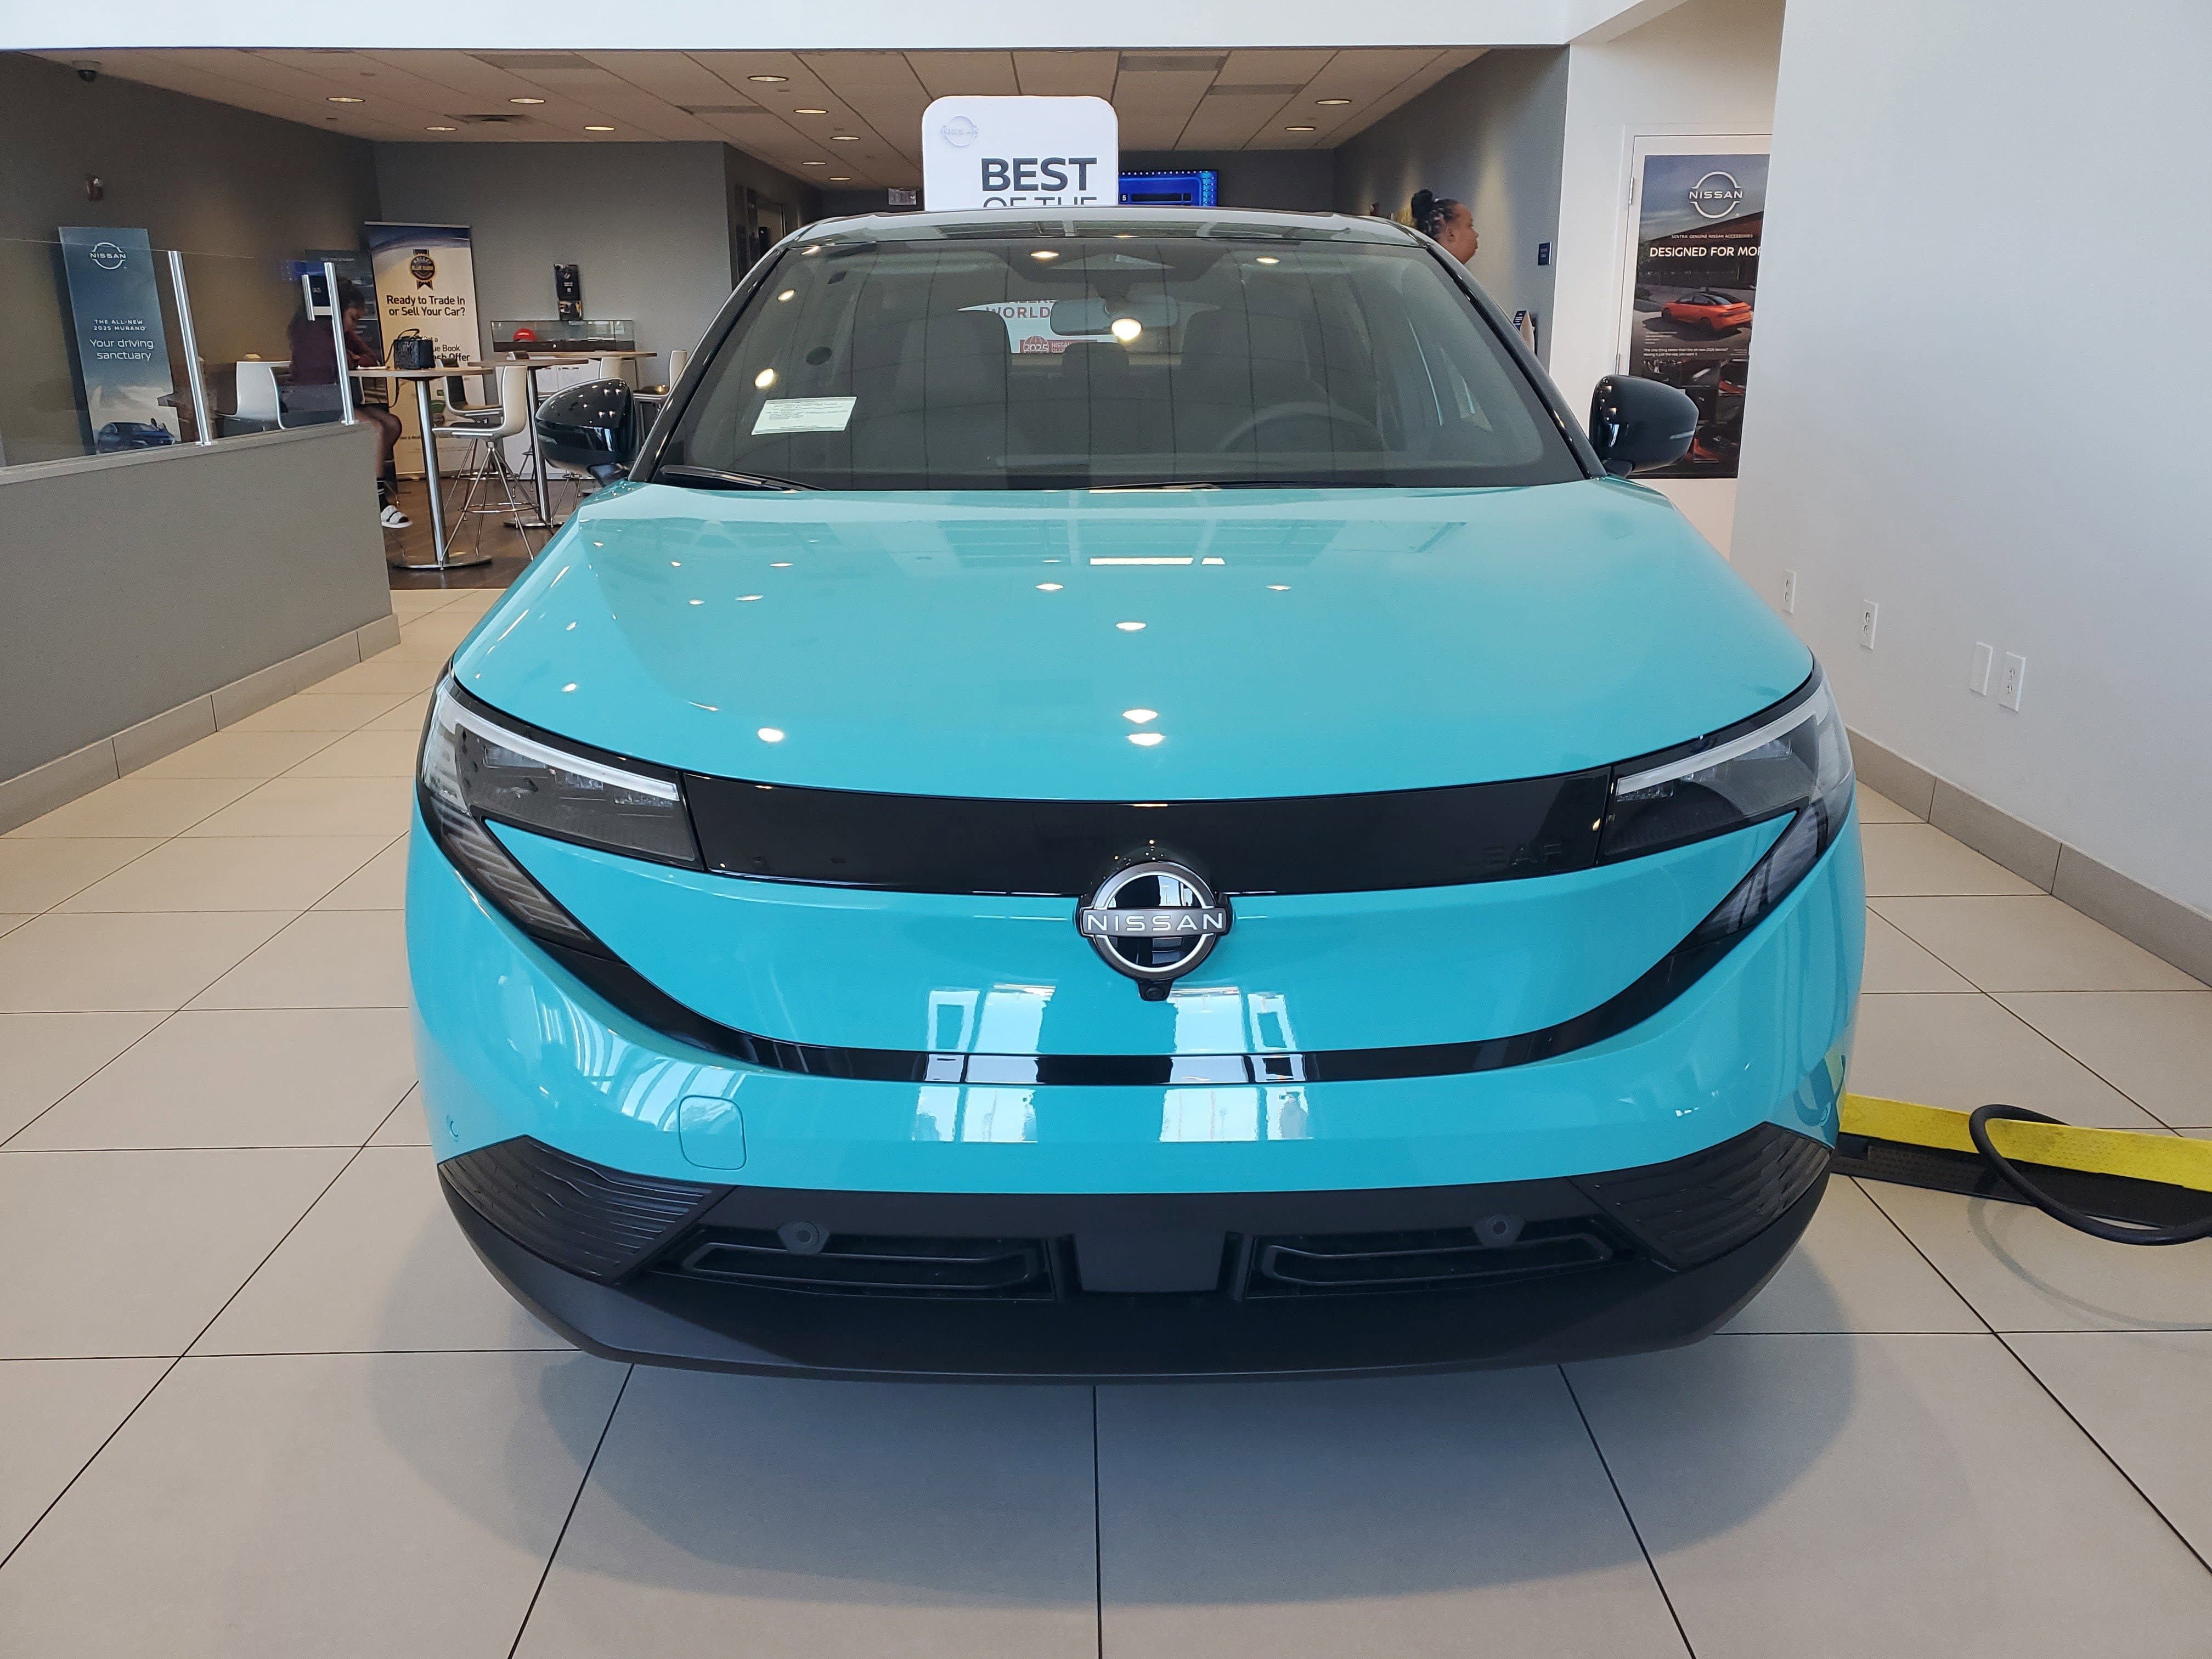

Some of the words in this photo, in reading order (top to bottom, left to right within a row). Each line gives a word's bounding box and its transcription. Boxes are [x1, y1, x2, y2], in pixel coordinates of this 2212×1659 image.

[981, 157, 1097, 191] BEST
[1689, 191, 1742, 199] NISSAN
[1650, 247, 1707, 257] DESIGNED
[1711, 246, 1734, 256] FOR
[386, 295, 415, 306] Ready
[428, 296, 455, 304] Trade
[457, 296, 465, 305] In
[401, 307, 419, 316] Sell
[421, 307, 442, 316] Your
[444, 307, 465, 316] Car?
[89, 339, 114, 347] Your
[117, 338, 154, 349] driving
[97, 352, 151, 361] sanctuary
[1087, 912, 1223, 932] NISSAN
